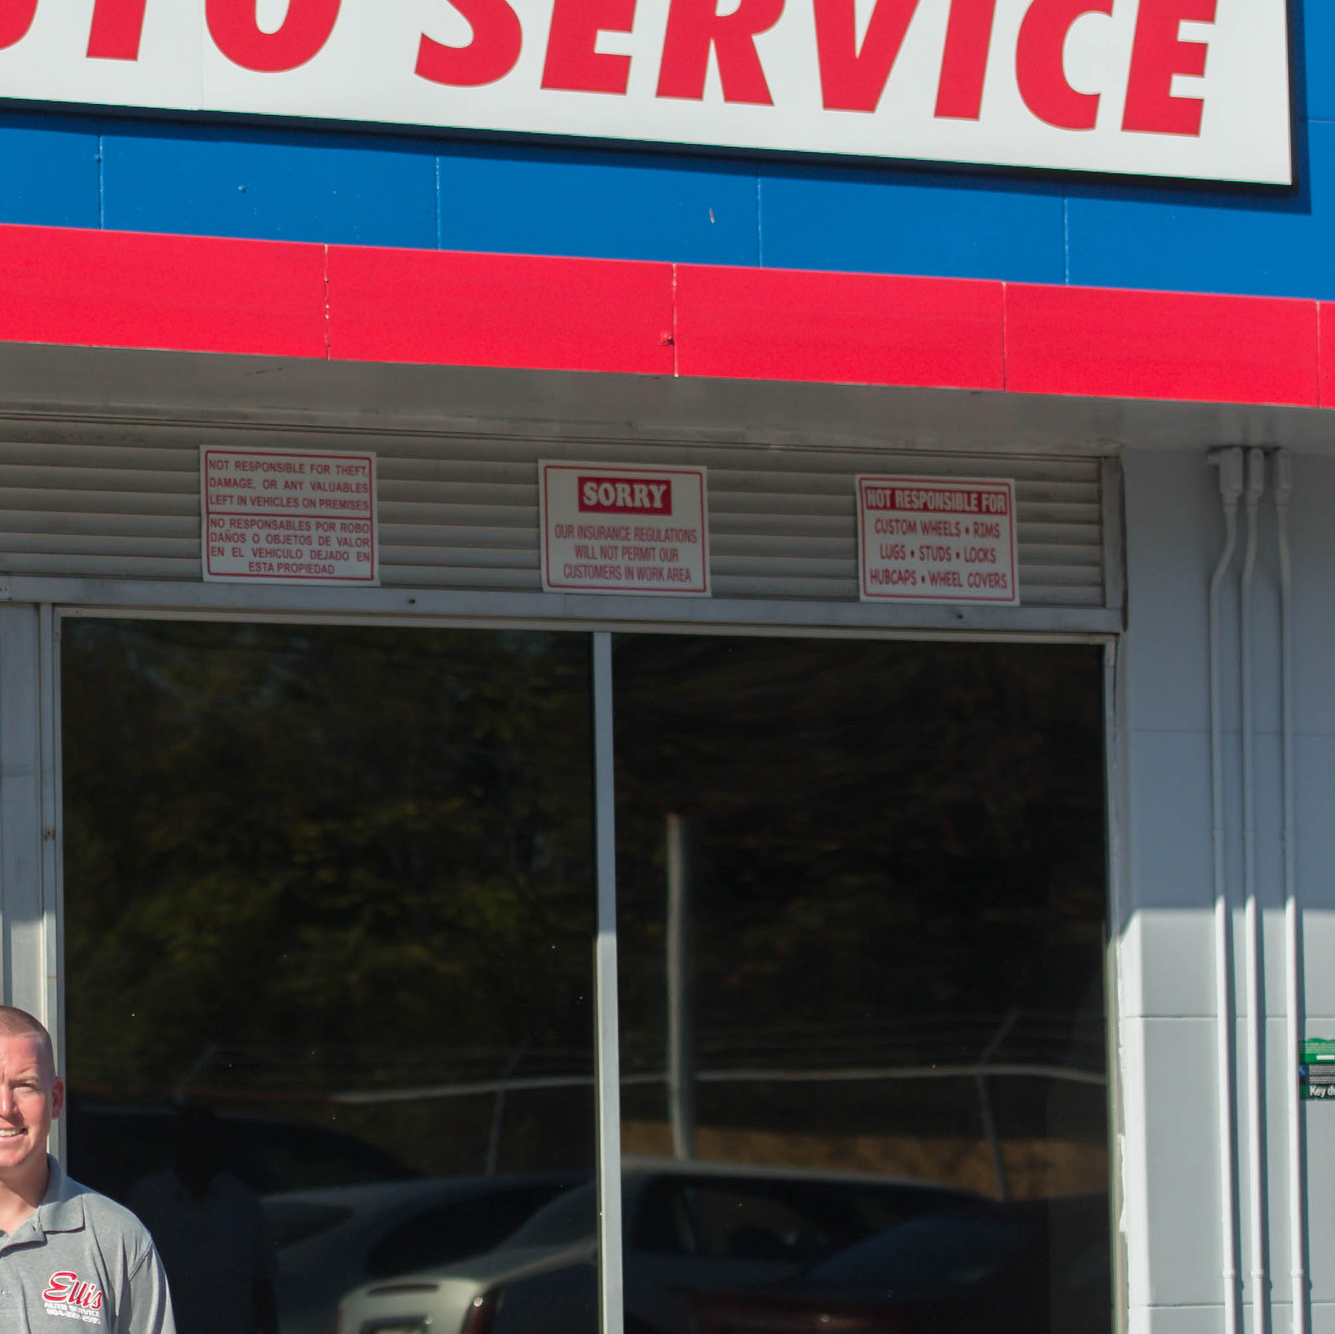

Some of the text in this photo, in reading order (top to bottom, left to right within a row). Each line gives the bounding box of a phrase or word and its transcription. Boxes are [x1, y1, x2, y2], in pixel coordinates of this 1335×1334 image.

[210, 460, 229, 470] NOT
[235, 461, 305, 474] RESPONSIBLE
[311, 464, 330, 473] FOR
[263, 480, 277, 489] OR
[284, 480, 303, 490] ANY
[310, 481, 368, 493] VALUABLES
[583, 482, 667, 508] SORRY
[210, 495, 369, 511] LEFT IN VEHICLES ON PREMISES
[867, 489, 1005, 512] NOT RESPONSIBLE FOR
[211, 519, 369, 533] NO RESPONSABLES POR ROBO
[555, 524, 697, 543] OUR INSURANCE REGULATIONS
[875, 519, 1000, 539] CUSTOM WHEELS RIMS
[211, 529, 369, 548] DAÑOS O OBJETOS DE VALOR
[211, 547, 224, 557] EN
[232, 548, 244, 557] EL
[311, 551, 349, 561] DEJADO
[357, 552, 369, 562] EN
[575, 545, 678, 562] WILL NOT PERMIT OUR
[880, 544, 996, 563] LUGS STUDS LOCKS
[249, 562, 334, 574] ESTA PROPIEDAD
[564, 564, 691, 582] CUSTOMERS IN WORK AREA
[870, 569, 1007, 589] HUBCAPS WHEEL COVERS
[1309, 1085, 1326, 1097] Key
[42, 1271, 103, 1309] Ellis
